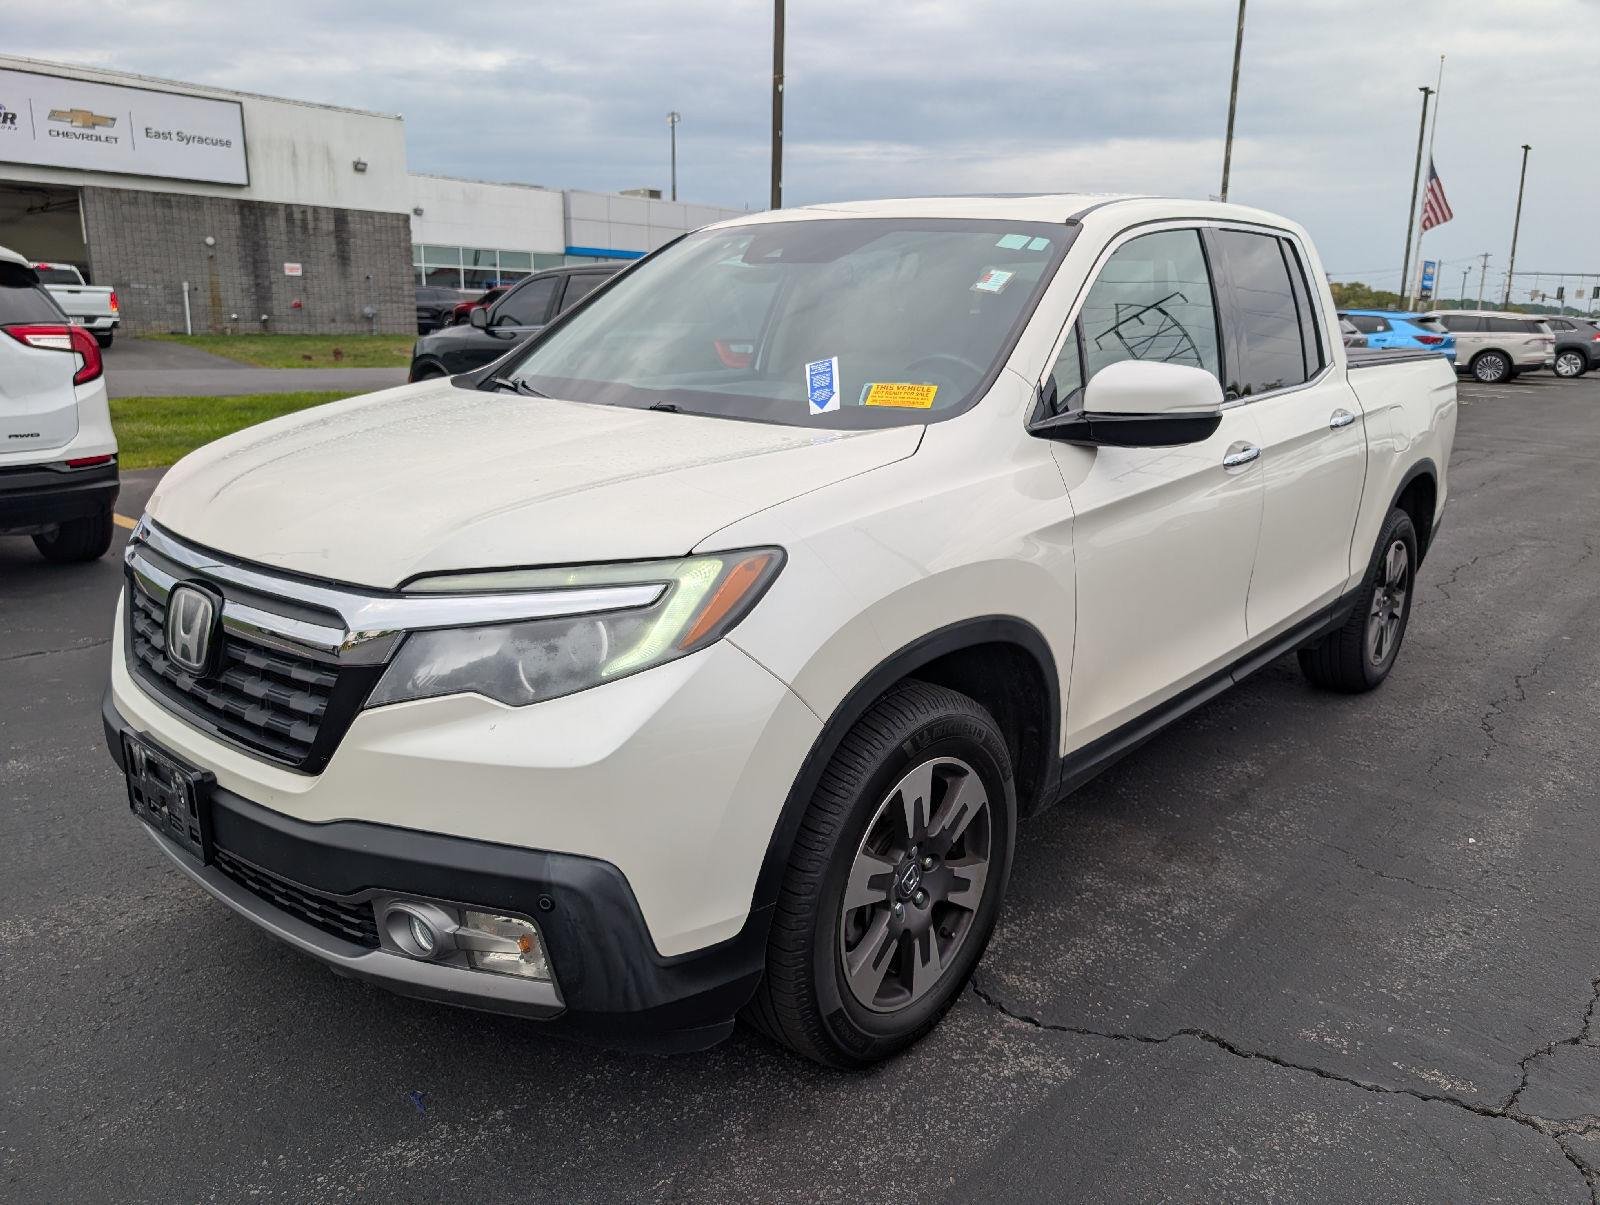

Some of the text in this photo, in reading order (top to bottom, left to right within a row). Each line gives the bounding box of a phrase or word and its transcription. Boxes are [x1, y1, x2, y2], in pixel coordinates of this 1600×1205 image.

[48, 128, 119, 144] CHEVROLET
[145, 127, 232, 148] East Syracuse
[876, 383, 932, 393] THIS VEHICLE
